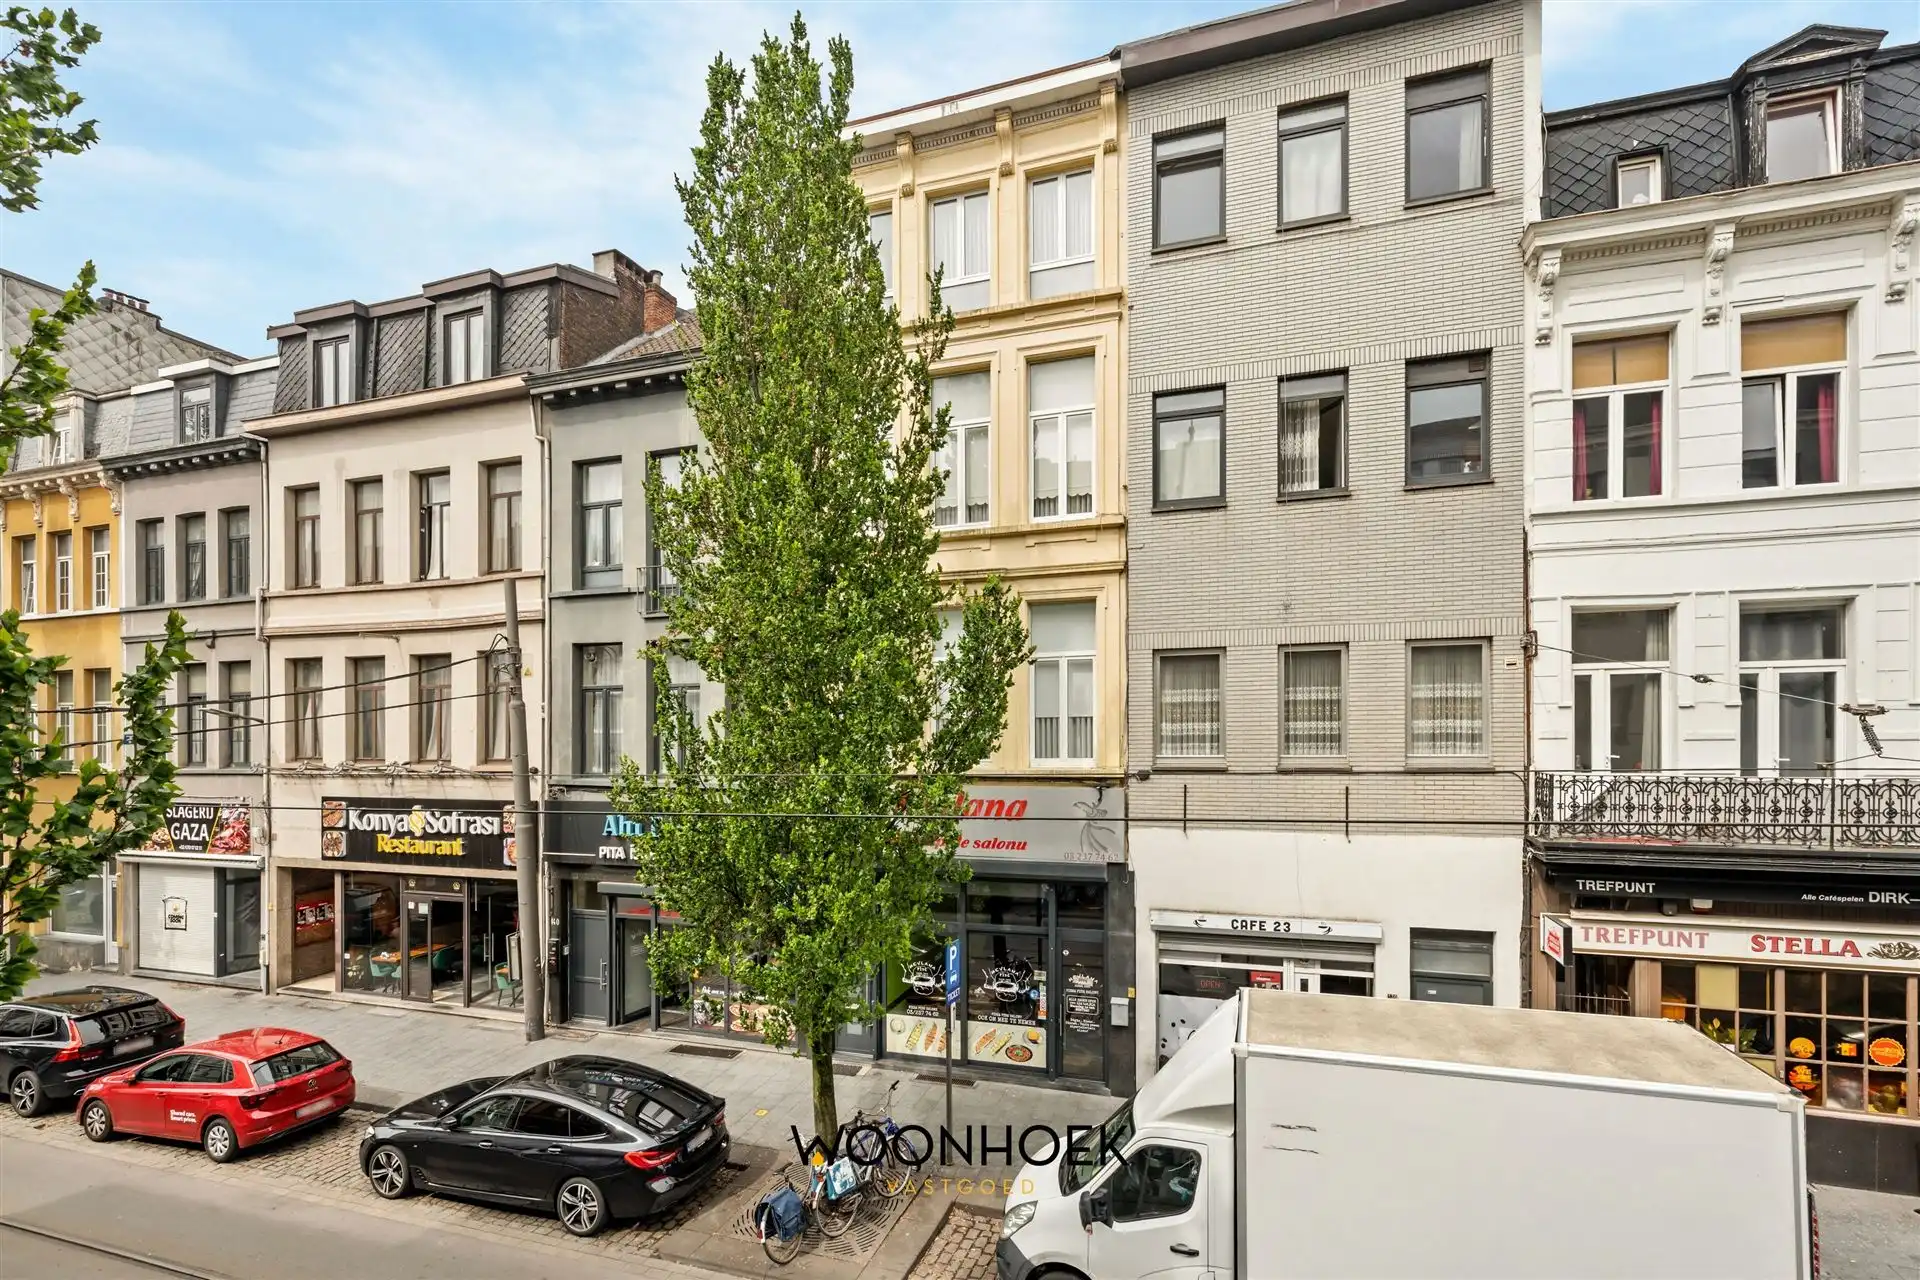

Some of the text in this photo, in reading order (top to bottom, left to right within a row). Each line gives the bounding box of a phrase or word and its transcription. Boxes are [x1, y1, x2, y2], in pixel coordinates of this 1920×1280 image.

[349, 808, 409, 837] Konya
[170, 823, 210, 841] GAZA
[376, 834, 466, 856] Restaurant
[972, 837, 1028, 850] salonu
[598, 846, 626, 859] PITA
[1575, 879, 1656, 894] TREFPUNT
[1801, 893, 1817, 901] Alle
[1818, 894, 1864, 903] Caféspelen
[1231, 919, 1291, 932] CAFE 23
[1581, 926, 1709, 949] TREFPUNT
[1751, 934, 1862, 958] STELLA
[949, 945, 957, 970] P
[947, 987, 960, 1001] TICKET
